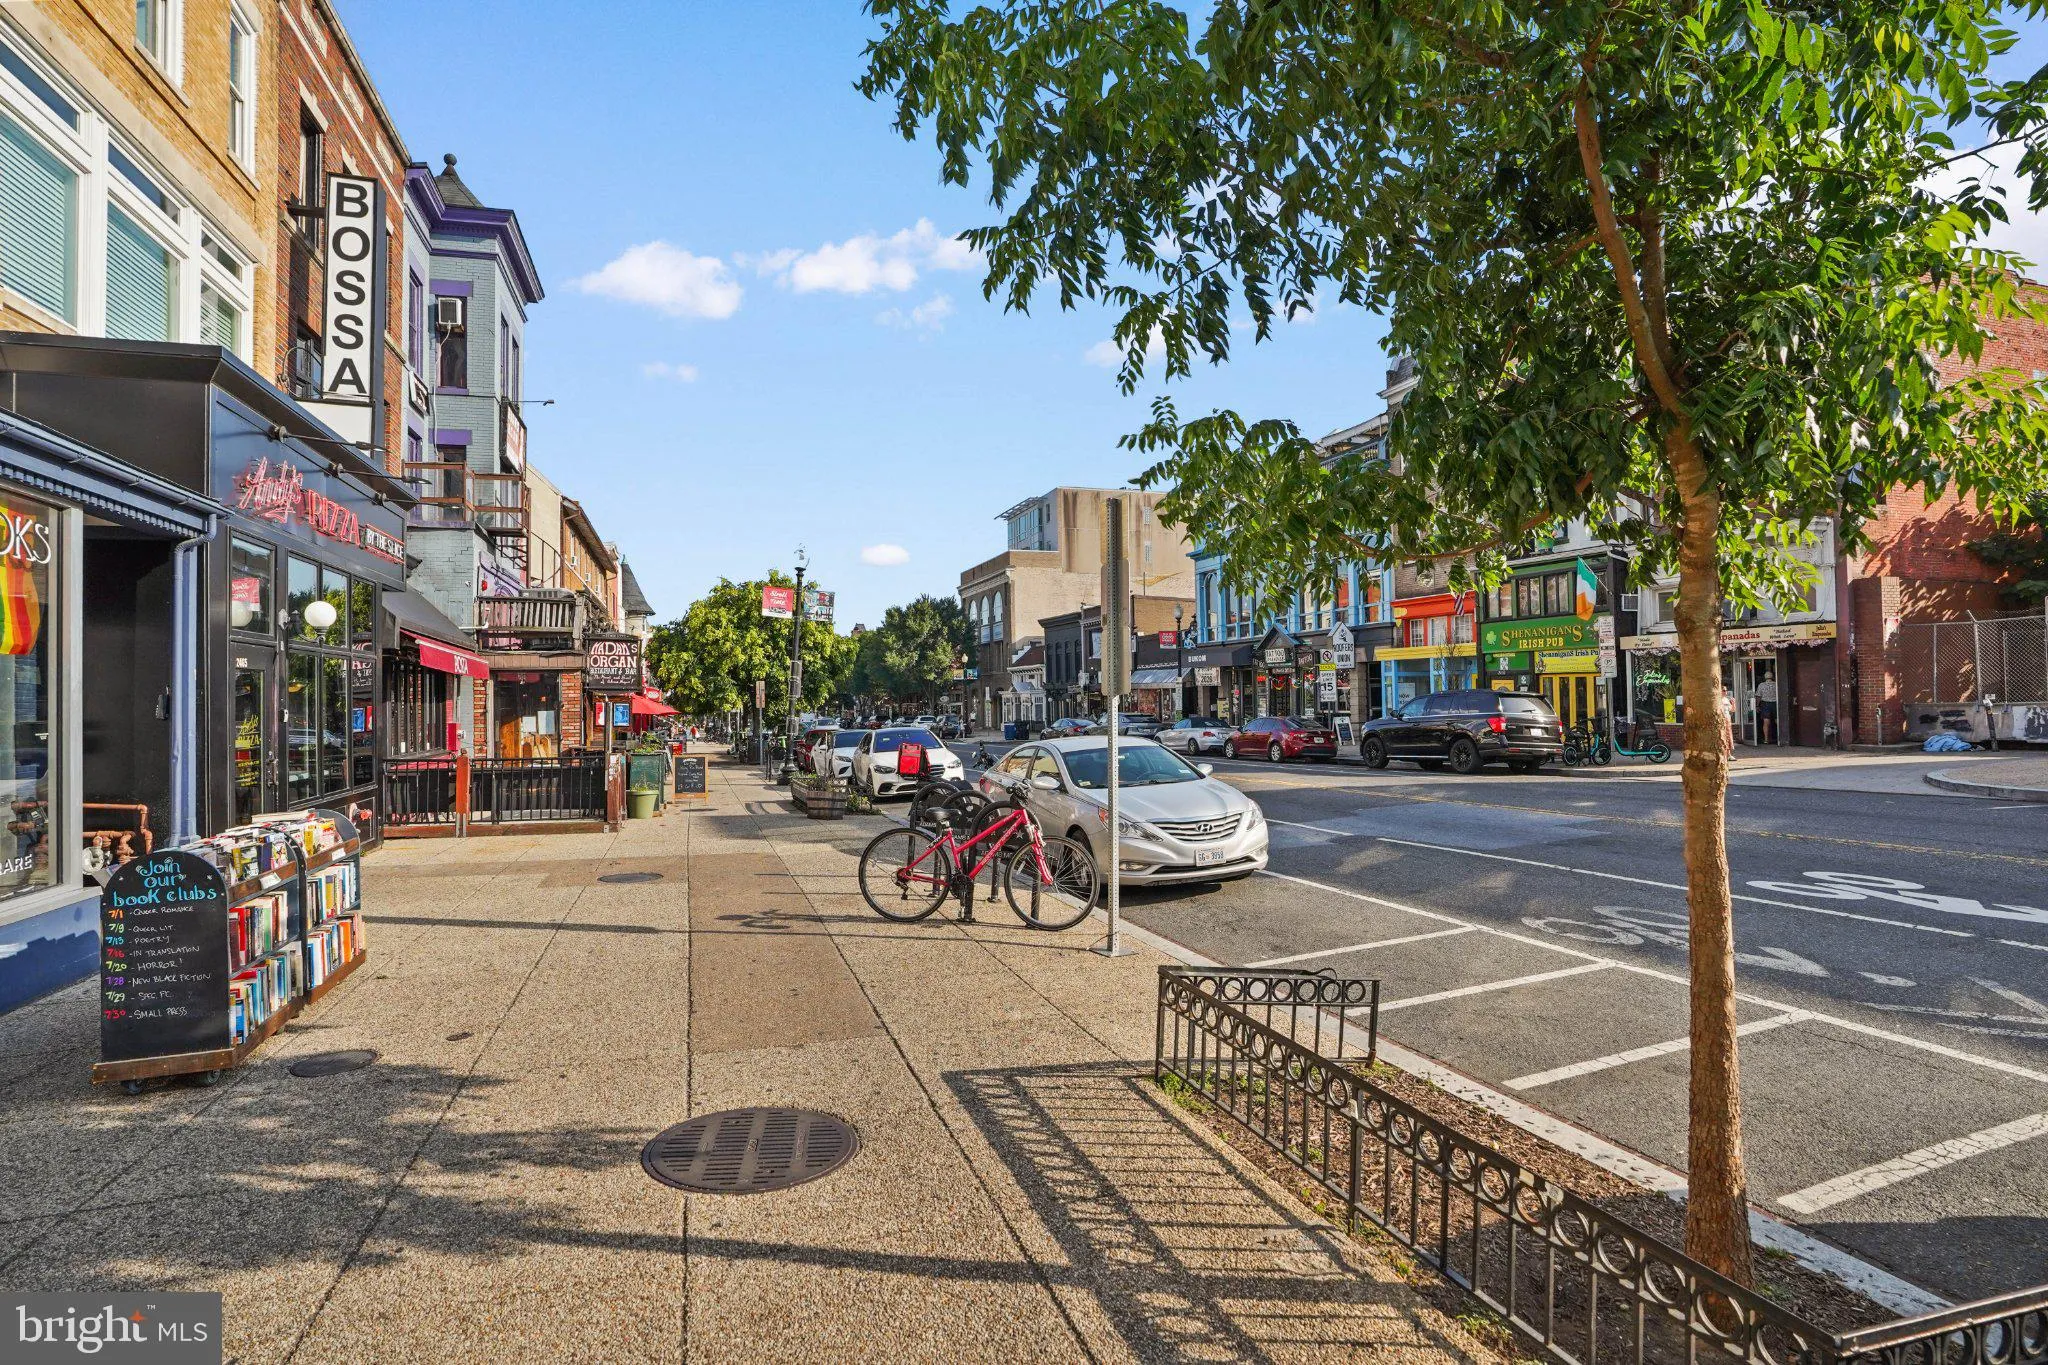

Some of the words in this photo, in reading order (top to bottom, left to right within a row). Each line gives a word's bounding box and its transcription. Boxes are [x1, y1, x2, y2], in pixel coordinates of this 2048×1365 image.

[328, 181, 370, 394] BOSSA
[239, 456, 303, 524] Andy's
[308, 490, 360, 546] PIZZA
[388, 539, 404, 560] SLICE
[1502, 624, 1583, 647] SHENANIGANS
[591, 642, 637, 655] MADAM'S
[1519, 639, 1544, 649] IRISH
[1546, 637, 1564, 648] PUB
[590, 655, 637, 667] ORGAN
[1322, 682, 1334, 692] 15
[144, 874, 181, 889] our
[166, 884, 218, 902] clubs
[109, 908, 124, 919] 7/1
[108, 923, 125, 933] 7/9
[145, 945, 200, 957] TRANSLATION
[105, 960, 127, 973] 7/20
[132, 977, 151, 987] NEW
[153, 975, 178, 983] BLACK
[179, 973, 211, 982] FICTION
[105, 991, 126, 1003] 7/29
[134, 1009, 162, 1020] SMALL
[166, 1006, 188, 1017] PRESS
